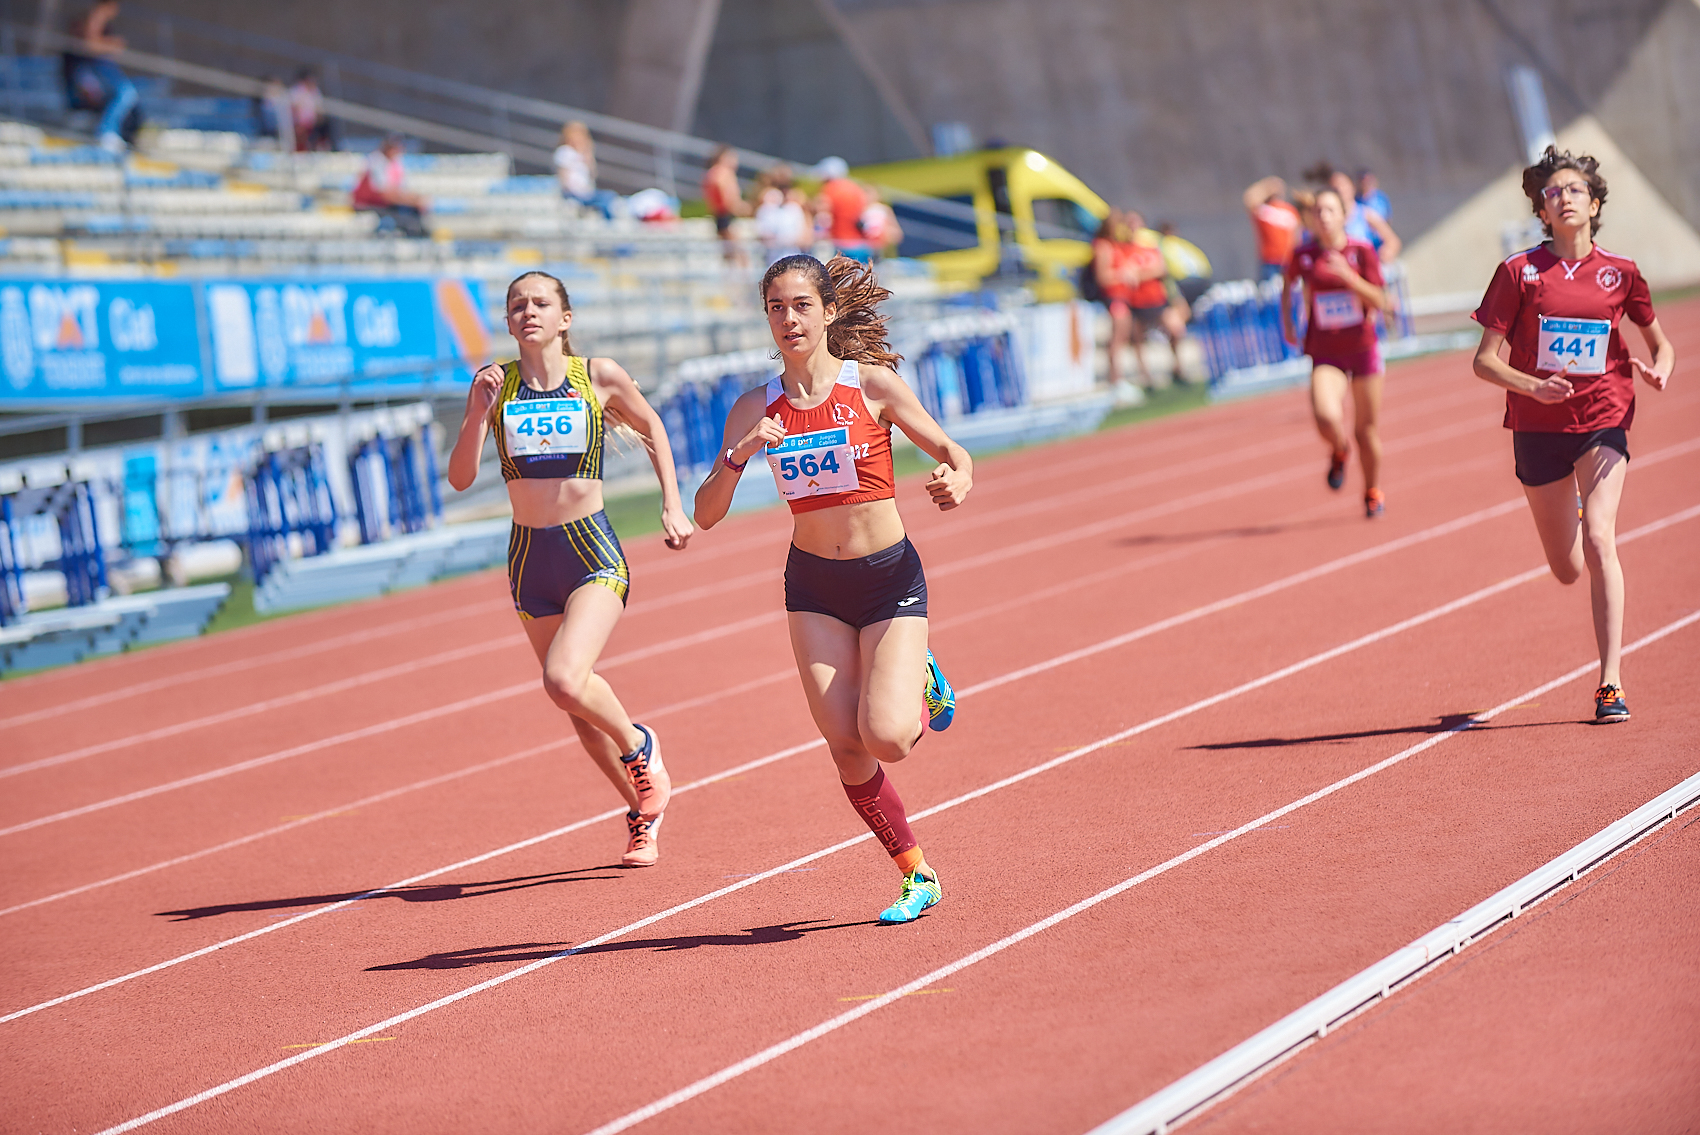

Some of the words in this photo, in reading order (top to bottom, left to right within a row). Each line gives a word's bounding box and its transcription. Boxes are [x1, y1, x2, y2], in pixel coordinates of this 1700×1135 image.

[1548, 336, 1596, 358] 441
[517, 416, 572, 436] 456
[780, 450, 840, 481] 564
